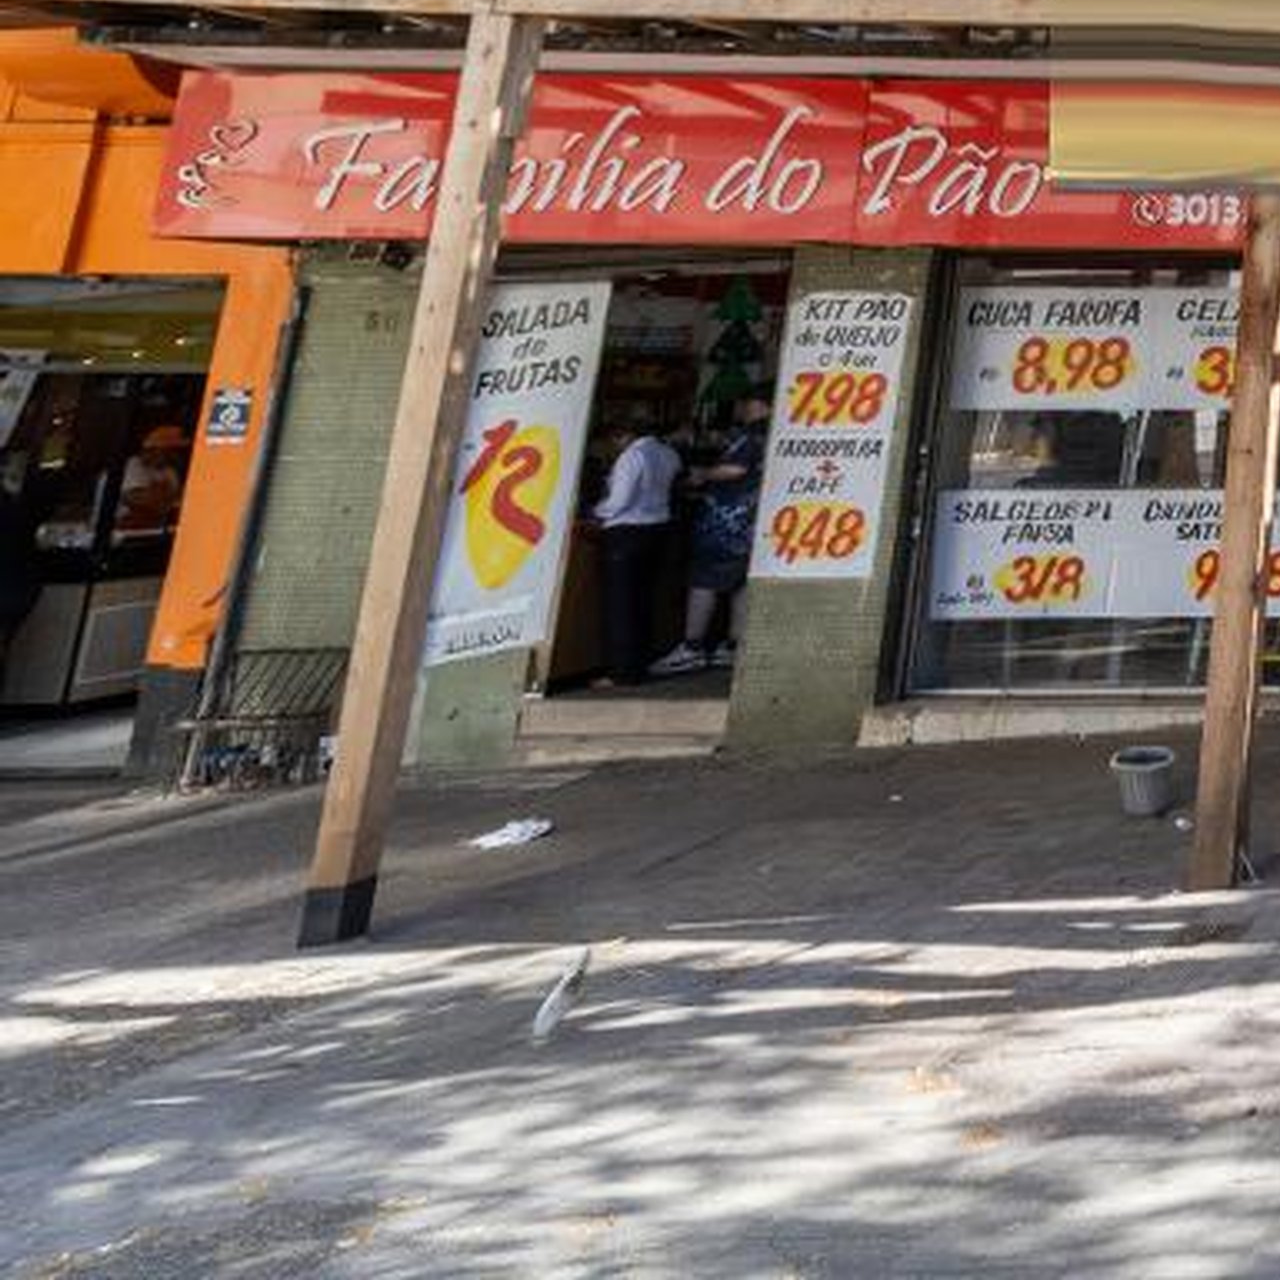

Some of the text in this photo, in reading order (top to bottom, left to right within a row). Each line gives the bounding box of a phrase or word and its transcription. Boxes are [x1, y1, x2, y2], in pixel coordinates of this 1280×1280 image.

[705, 105, 823, 214] do
[862, 124, 1042, 217] Pão
[482, 297, 590, 338] SALADA
[804, 299, 851, 320] KIT
[968, 299, 1142, 327] CUCA FAROFA
[474, 355, 582, 399] FRUTAS
[1013, 336, 1130, 394] 8,98
[789, 371, 888, 427] 7,98
[773, 505, 865, 563] 9,48
